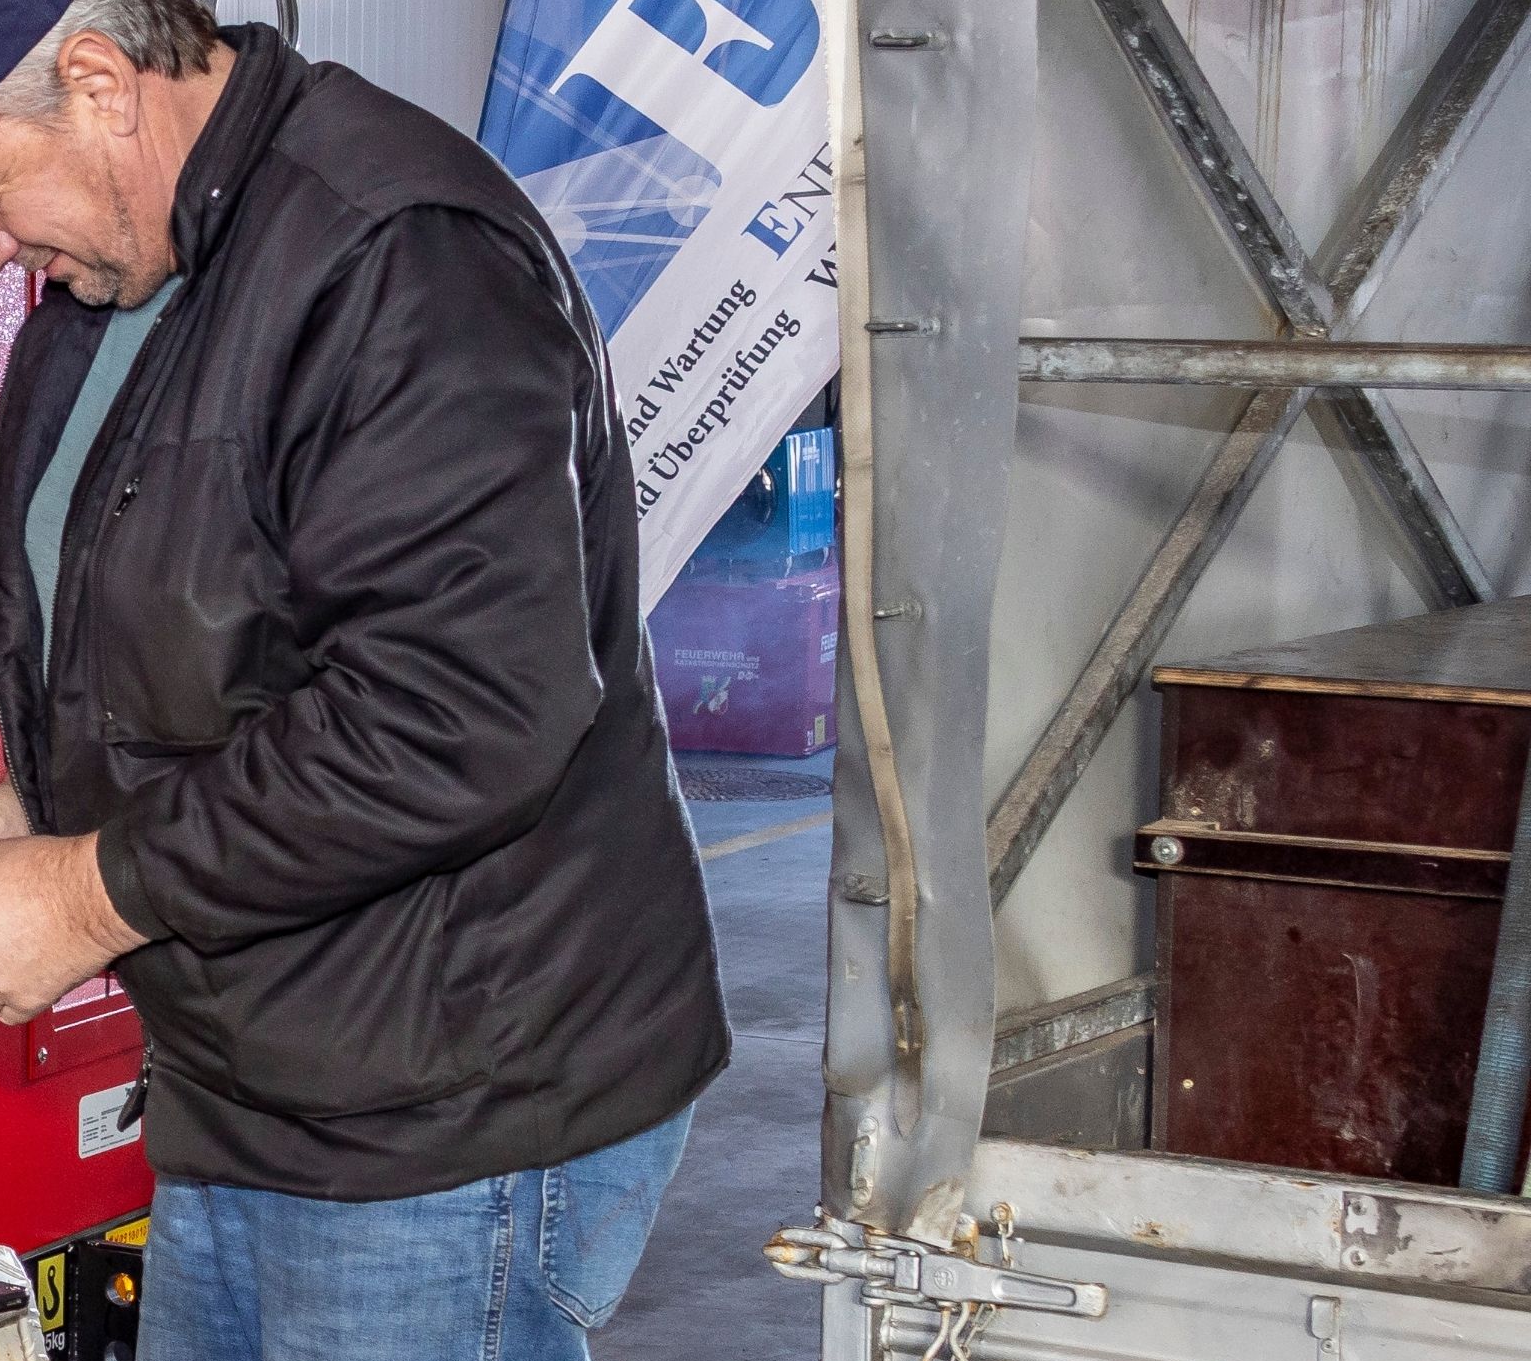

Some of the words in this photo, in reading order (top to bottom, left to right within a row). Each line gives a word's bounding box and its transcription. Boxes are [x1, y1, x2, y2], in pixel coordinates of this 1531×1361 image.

[626, 393, 662, 447] nd
[647, 278, 757, 394] Wartung
[647, 308, 802, 482] Überprüfung
[674, 649, 744, 662] FEUERWEHR
